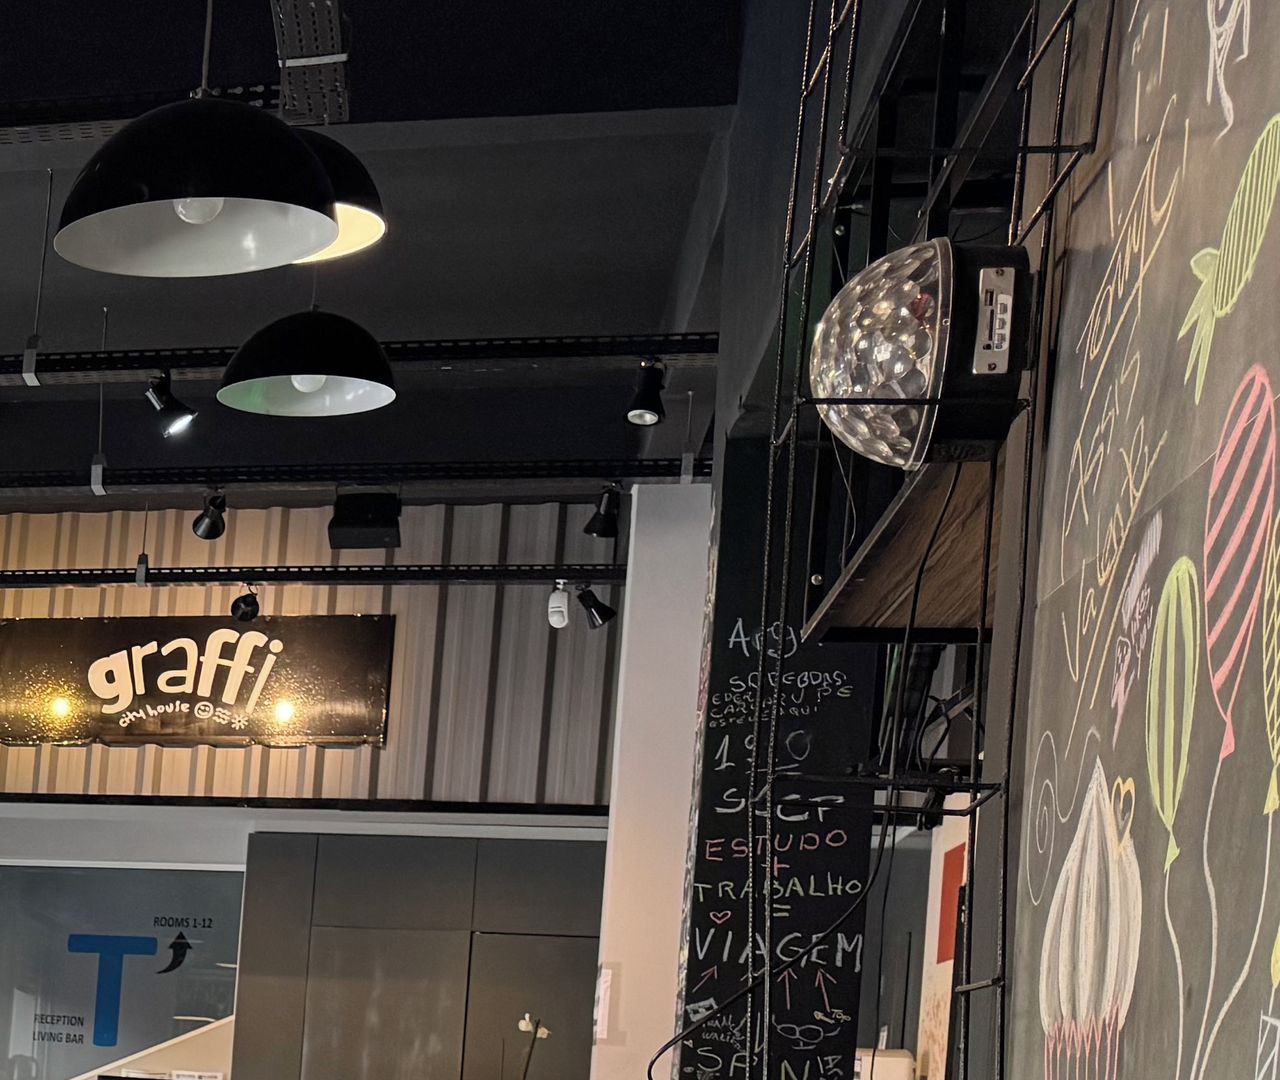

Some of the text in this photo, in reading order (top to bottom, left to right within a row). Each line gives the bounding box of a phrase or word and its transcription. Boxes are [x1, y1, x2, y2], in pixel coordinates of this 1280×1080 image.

[88, 628, 284, 714] graffi
[119, 709, 146, 728] city
[705, 829, 848, 861] ESTUDO
[694, 872, 862, 902] TRABALHO
[153, 916, 213, 928] ROOMS 1-12
[695, 927, 864, 973] VIAGEM
[34, 1014, 85, 1027] RECEPTION
[33, 1032, 84, 1044] LIVING BAR
